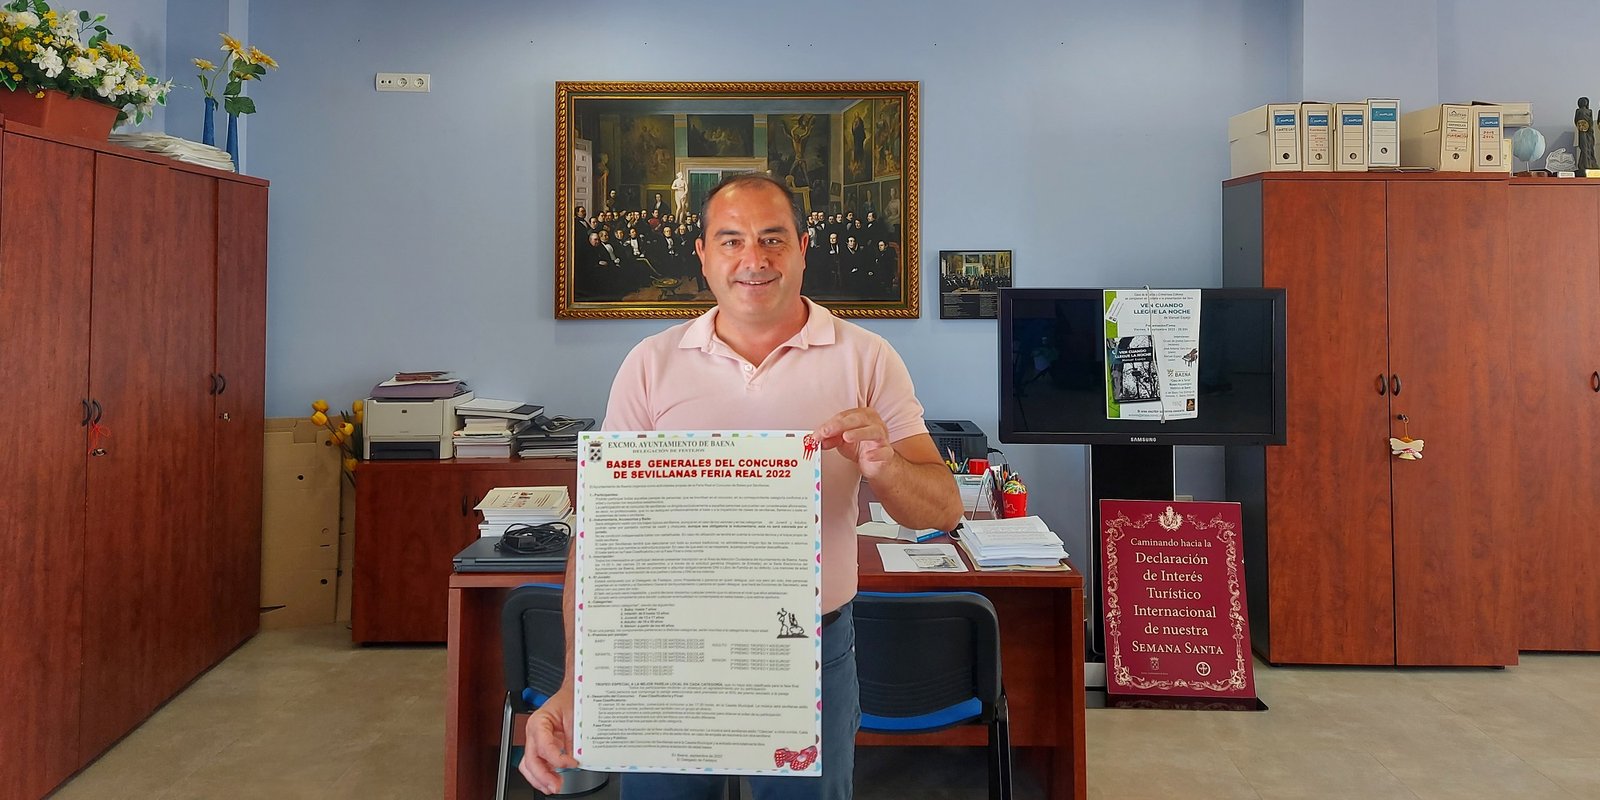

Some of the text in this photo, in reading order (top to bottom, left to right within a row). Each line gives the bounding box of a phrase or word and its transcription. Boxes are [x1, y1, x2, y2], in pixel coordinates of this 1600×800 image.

[608, 441, 637, 449] EXCMO.
[639, 440, 698, 449] AYUNTAMIENTO
[606, 459, 798, 468] BASES GENERALES DEL CONCURSO
[613, 471, 627, 479] DE
[631, 470, 698, 479] SEVILLANAS
[701, 470, 732, 478] FERIA
[1130, 538, 1212, 548] Caminando hacia la
[1136, 552, 1208, 565] Declaración
[1143, 570, 1203, 582] de Interés
[1146, 587, 1201, 600] Turístico
[1134, 605, 1216, 618] Internacional
[1144, 623, 1209, 636] de nuestra
[1132, 641, 1224, 655] SEMANA SANTA
